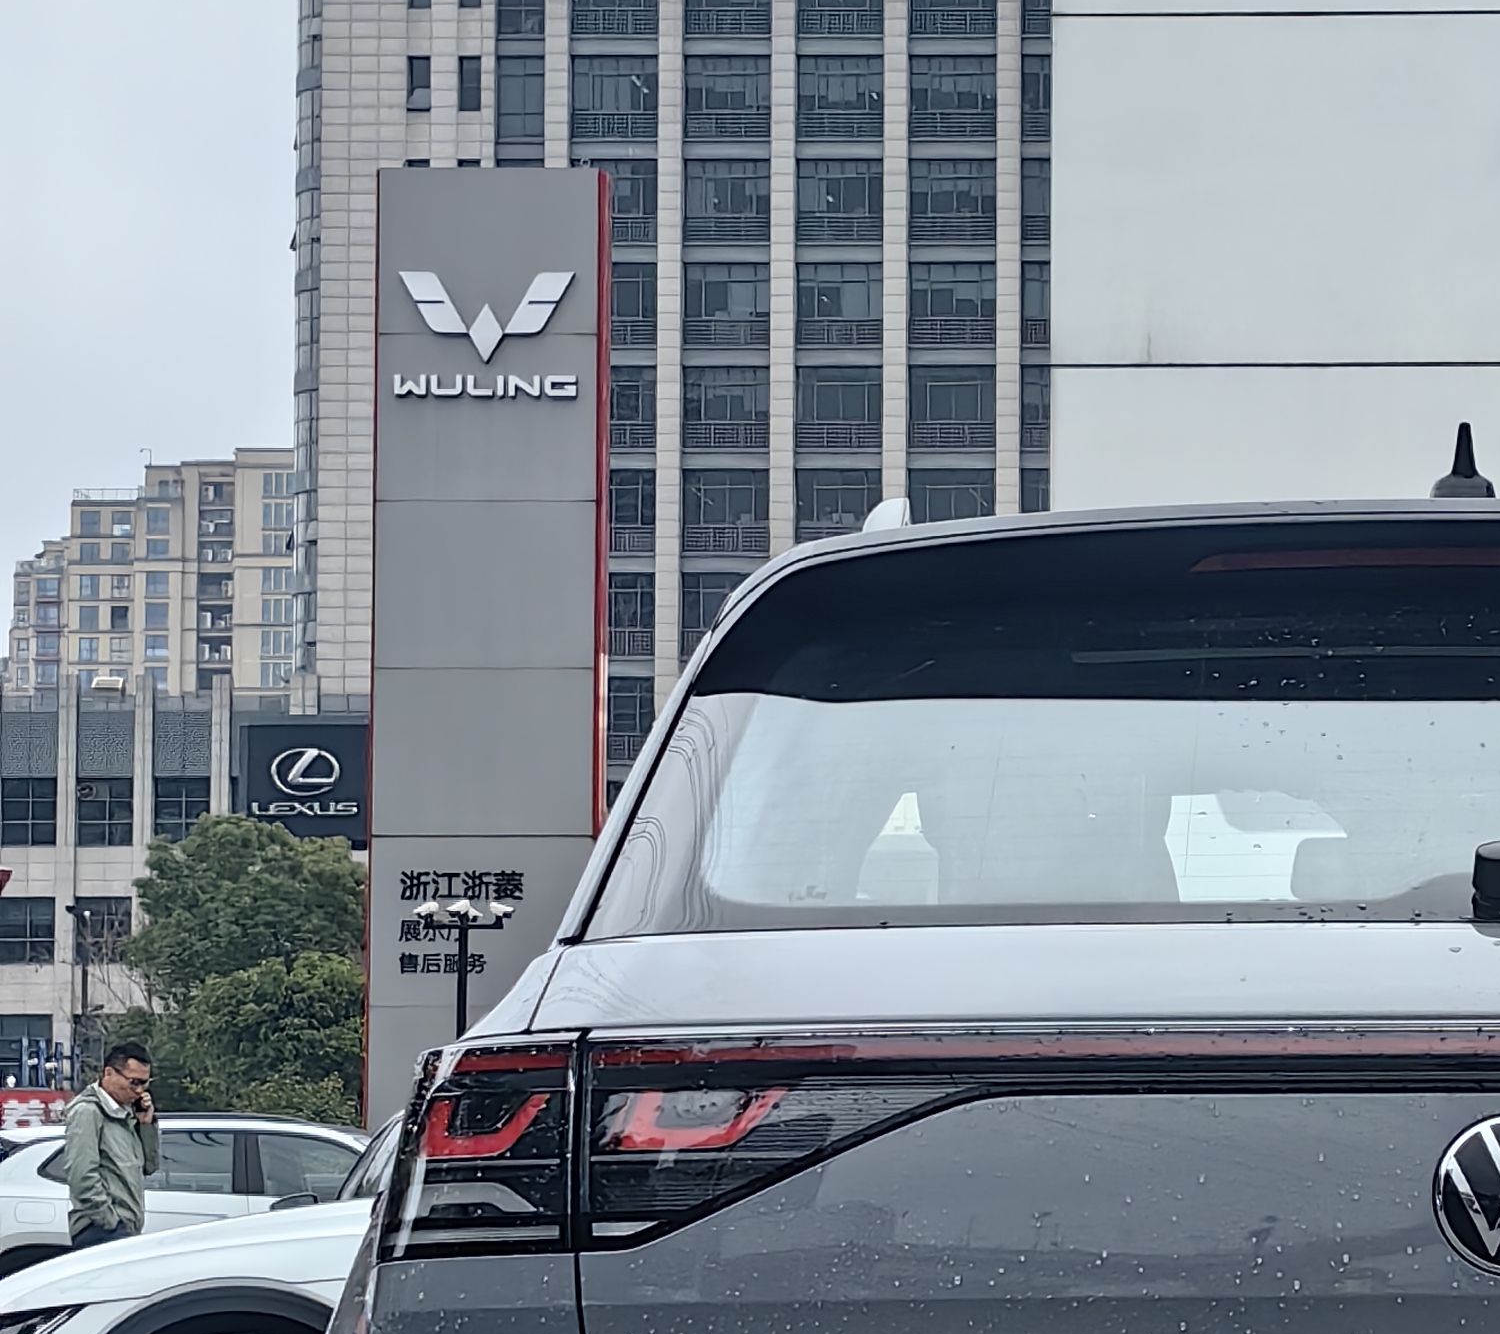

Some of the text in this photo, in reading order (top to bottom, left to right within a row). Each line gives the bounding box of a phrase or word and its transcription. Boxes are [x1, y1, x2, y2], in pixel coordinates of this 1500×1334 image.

[394, 373, 579, 399] WULING
[251, 801, 359, 817] LEXUS
[399, 870, 525, 901] 浙江浙菱
